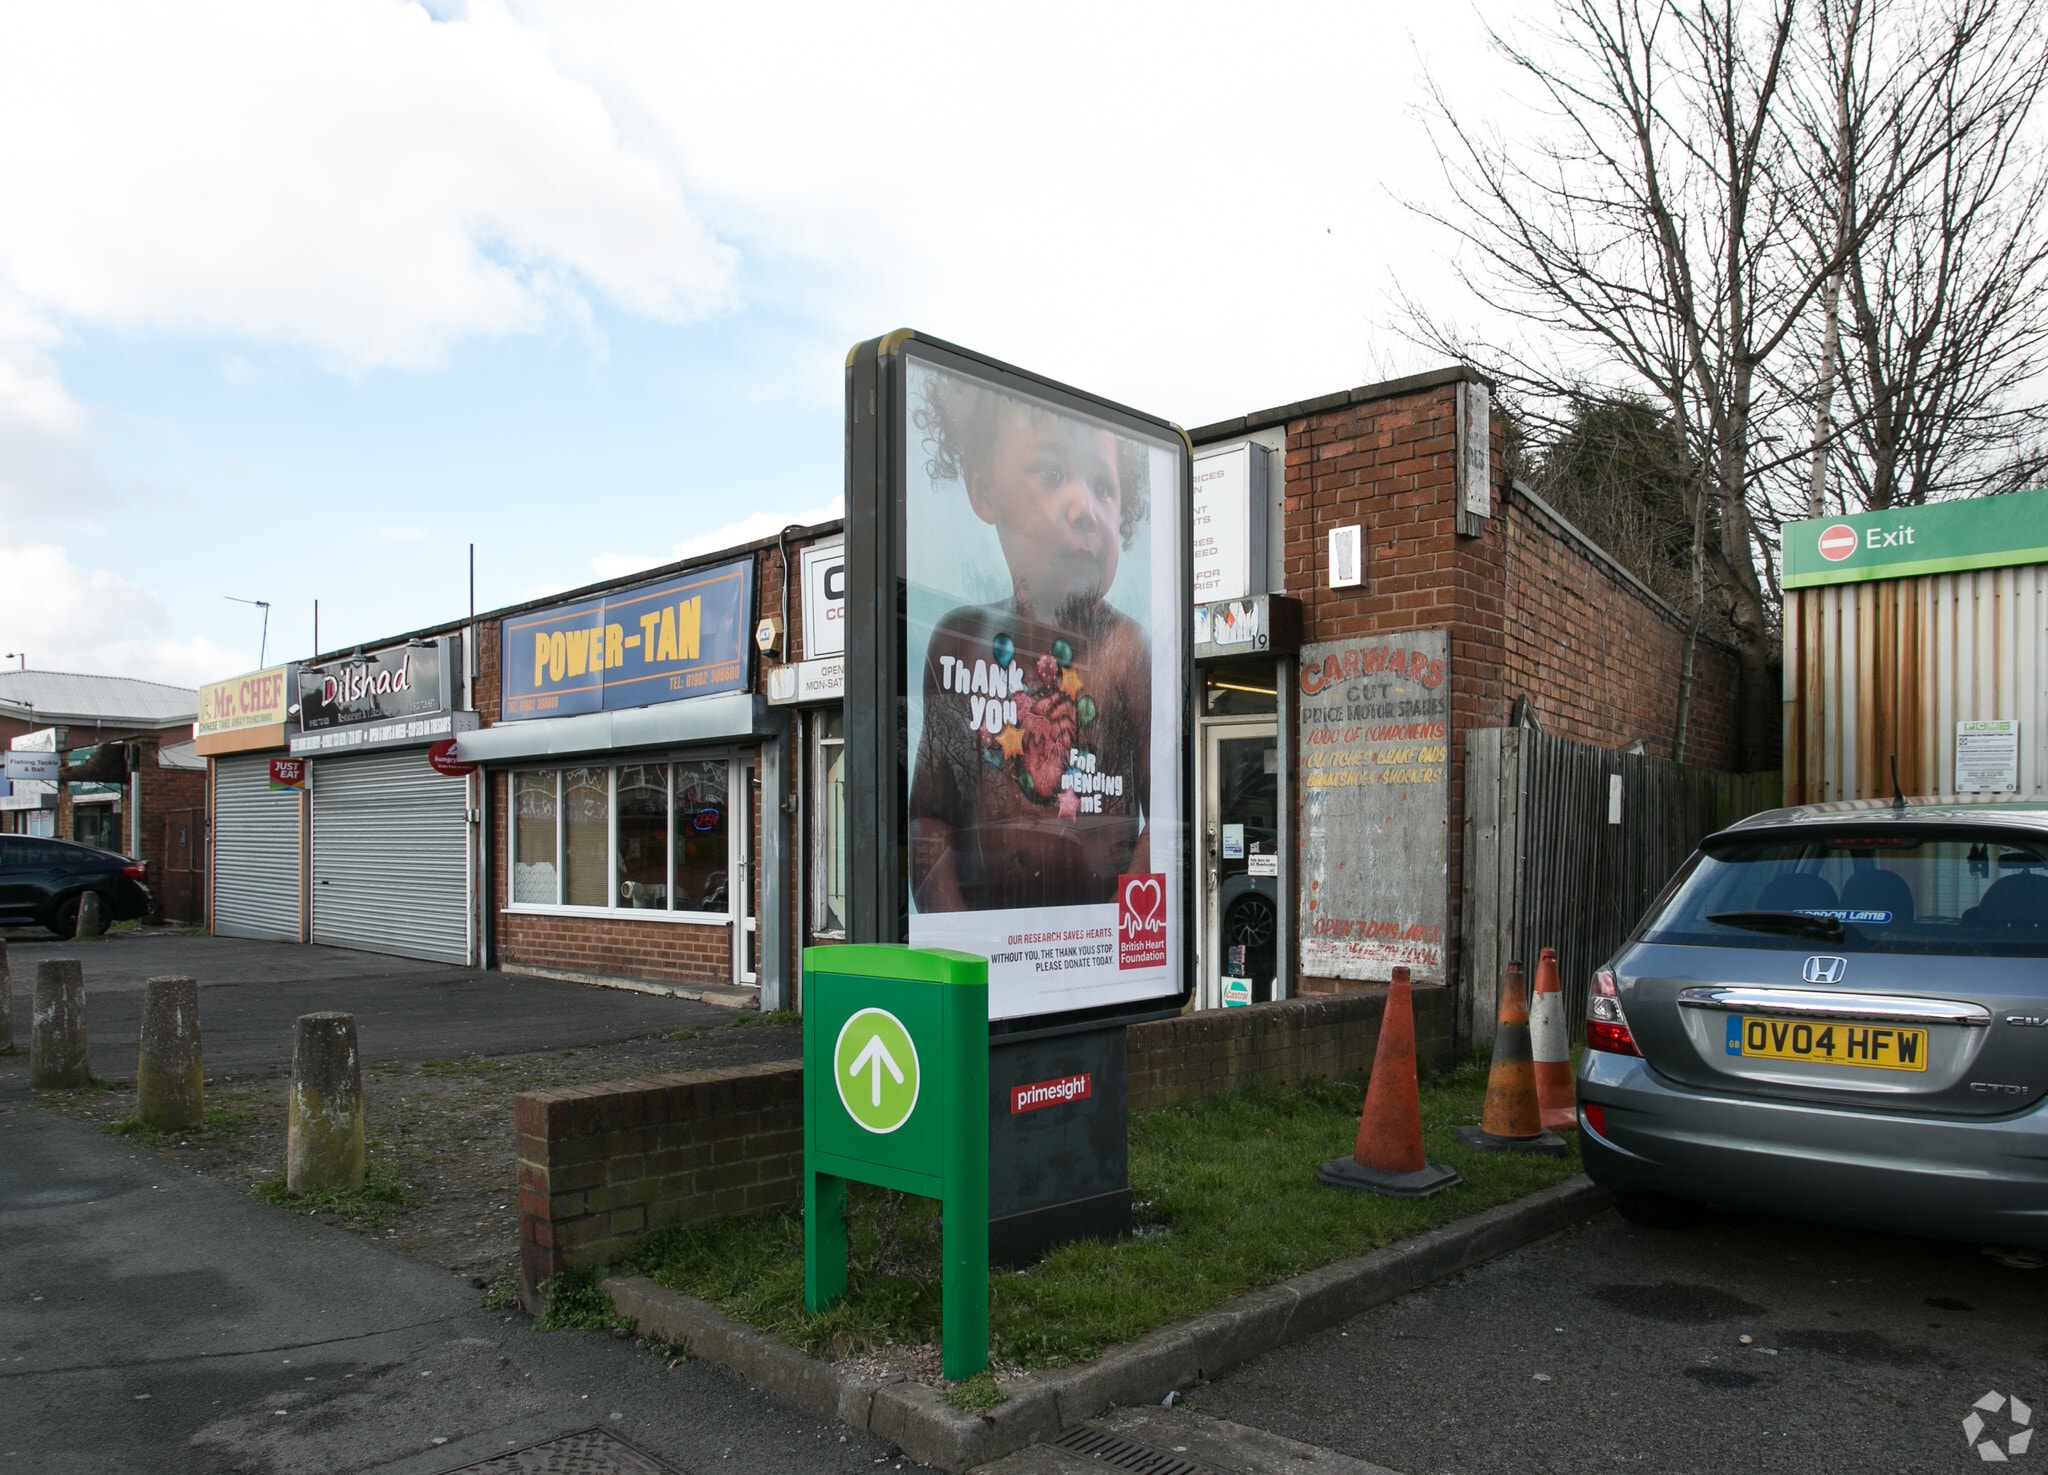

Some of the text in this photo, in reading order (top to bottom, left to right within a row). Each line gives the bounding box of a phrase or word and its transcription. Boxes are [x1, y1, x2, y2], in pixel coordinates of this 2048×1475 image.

[1866, 525, 1915, 549] Exit
[1196, 569, 1221, 580] FOR
[533, 594, 702, 688] POWER-TAN
[1252, 634, 1268, 649] 19
[321, 651, 411, 707] Dilshad
[821, 665, 845, 677] OPEN
[1300, 645, 1447, 696] CARWARS
[669, 676, 684, 691] TEL:
[685, 671, 708, 689] 01902
[805, 677, 844, 692] MON-SAT
[213, 673, 283, 719] Mr. CHEF
[1346, 683, 1393, 702] CUT
[1302, 698, 1447, 725] PRICE MOTOR SPARES
[10, 759, 59, 767] Fishing Tackle
[1417, 745, 1447, 764] PADS
[275, 762, 300, 771] JUST
[1849, 911, 1886, 920] LAMB
[1008, 928, 1113, 945] OUR RESEARCH SAVES HEARTS.
[1313, 918, 1355, 937] OPEN
[991, 952, 1023, 964] WITHOUT
[1041, 949, 1054, 959] THE
[1055, 947, 1078, 957] THANK
[1078, 946, 1096, 956] YOUS
[1096, 944, 1114, 955] STOP.
[1121, 939, 1165, 951] British Heart
[1036, 956, 1115, 972] PLEASE DONATE TODAY.
[1121, 951, 1165, 964] Foundation
[1226, 990, 1248, 1000] Castrol
[1729, 1040, 1740, 1048] GB
[1748, 1021, 1919, 1064] OV04 HFW
[1017, 1076, 1086, 1110] primesight
